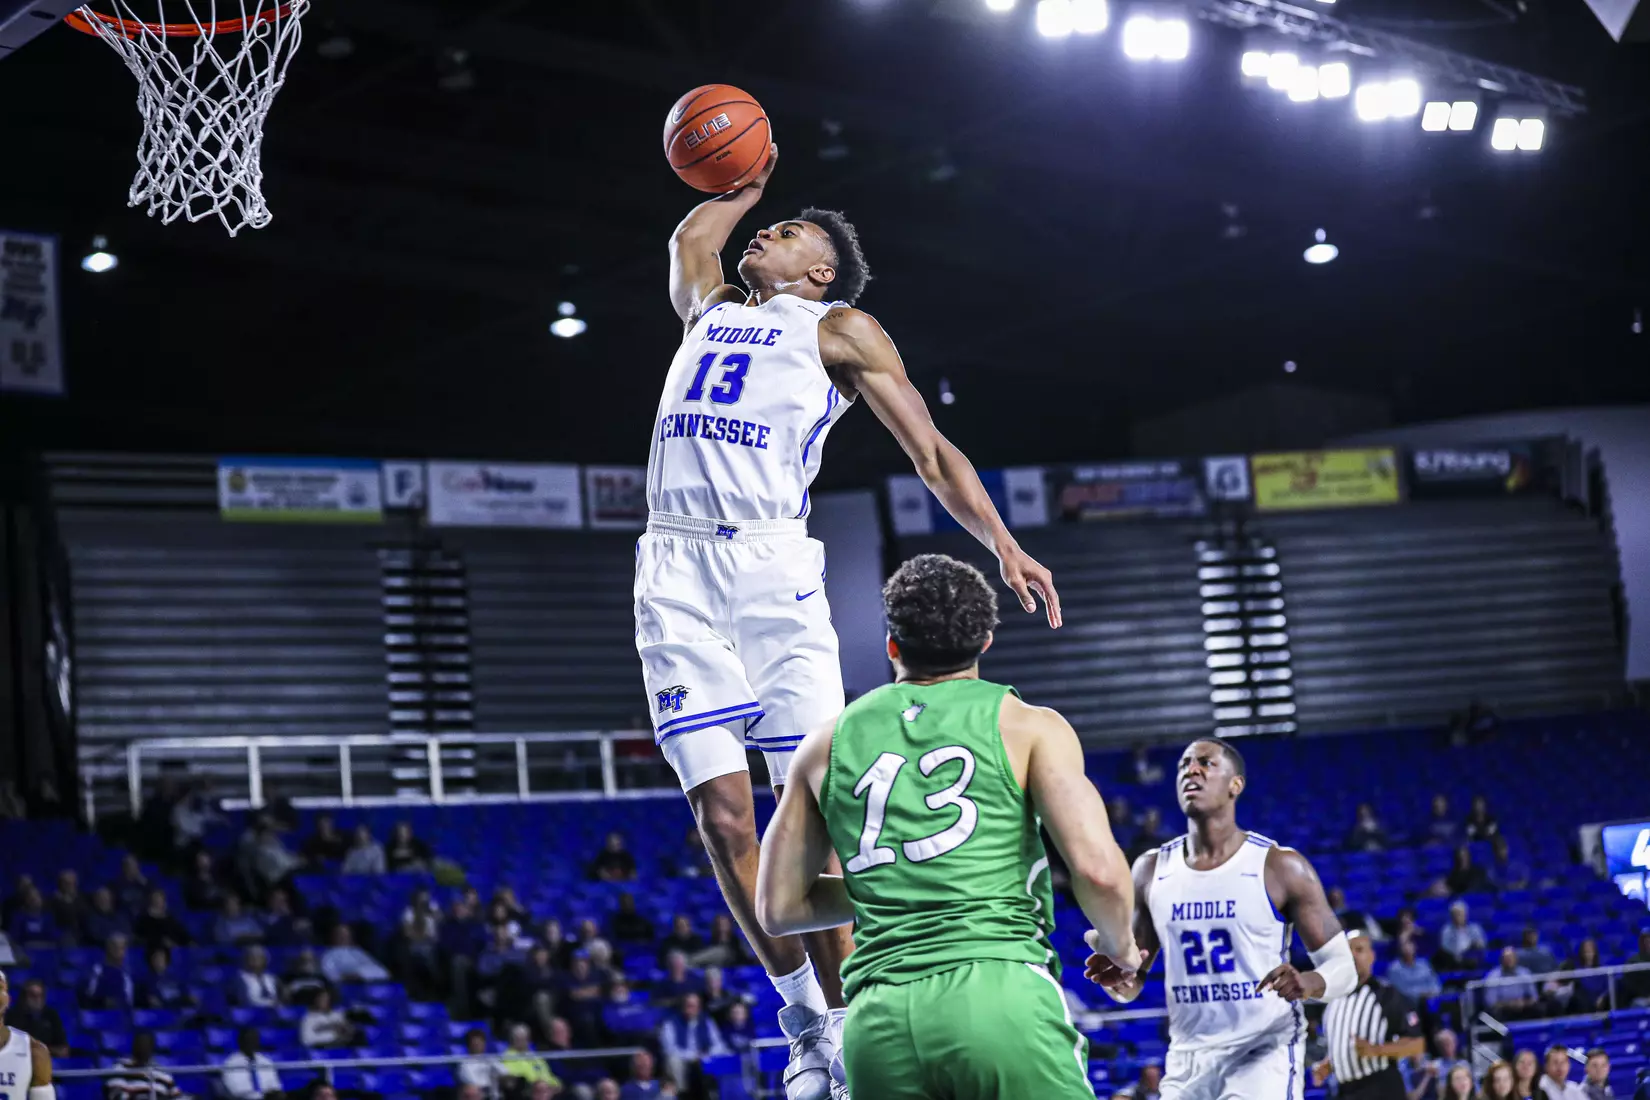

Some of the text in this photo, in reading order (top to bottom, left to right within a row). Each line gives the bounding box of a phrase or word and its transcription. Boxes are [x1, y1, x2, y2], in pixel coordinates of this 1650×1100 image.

[684, 112, 732, 150] ELITE
[703, 323, 783, 347] MIDDLE
[683, 351, 753, 407] 13
[660, 413, 771, 450] TENNESSEE
[656, 687, 688, 713] MT
[846, 744, 978, 874] 13
[1171, 900, 1236, 922] MIDDLE
[1180, 928, 1237, 976] 22
[1172, 981, 1264, 1004] TENNESSEE
